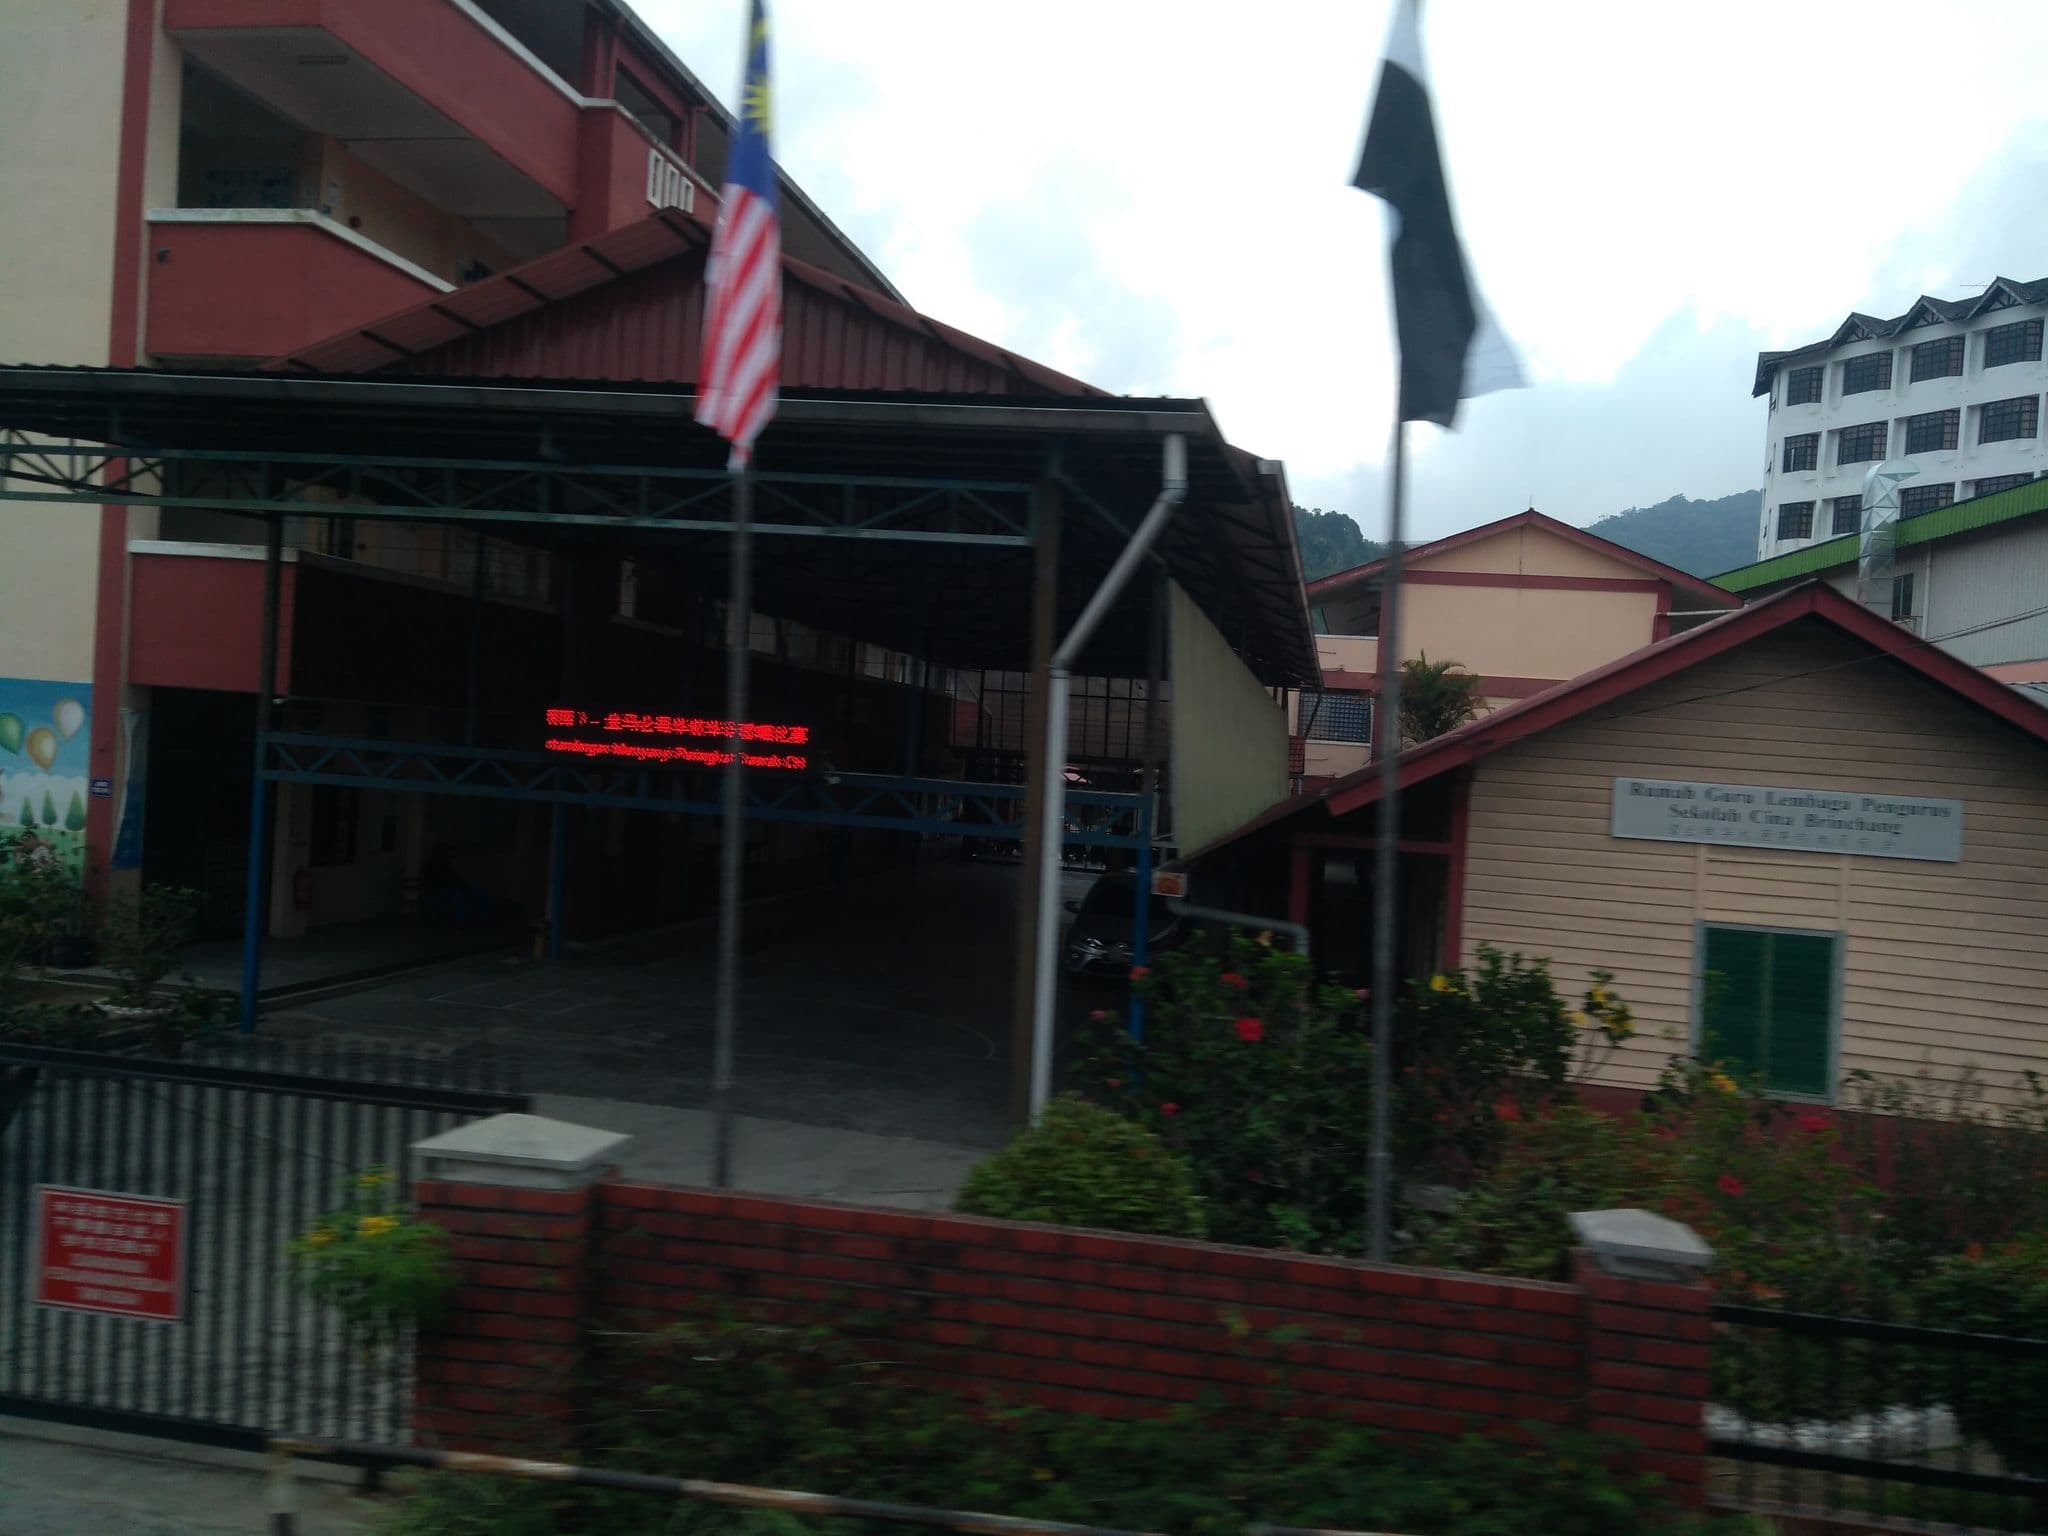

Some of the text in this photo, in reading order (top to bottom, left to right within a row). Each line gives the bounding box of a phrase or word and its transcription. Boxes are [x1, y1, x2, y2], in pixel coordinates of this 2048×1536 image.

[1630, 782, 1953, 818] Rumah Guru Lembaga Pengurus
[1666, 803, 1904, 835] Sekolah Cina Brinchang
